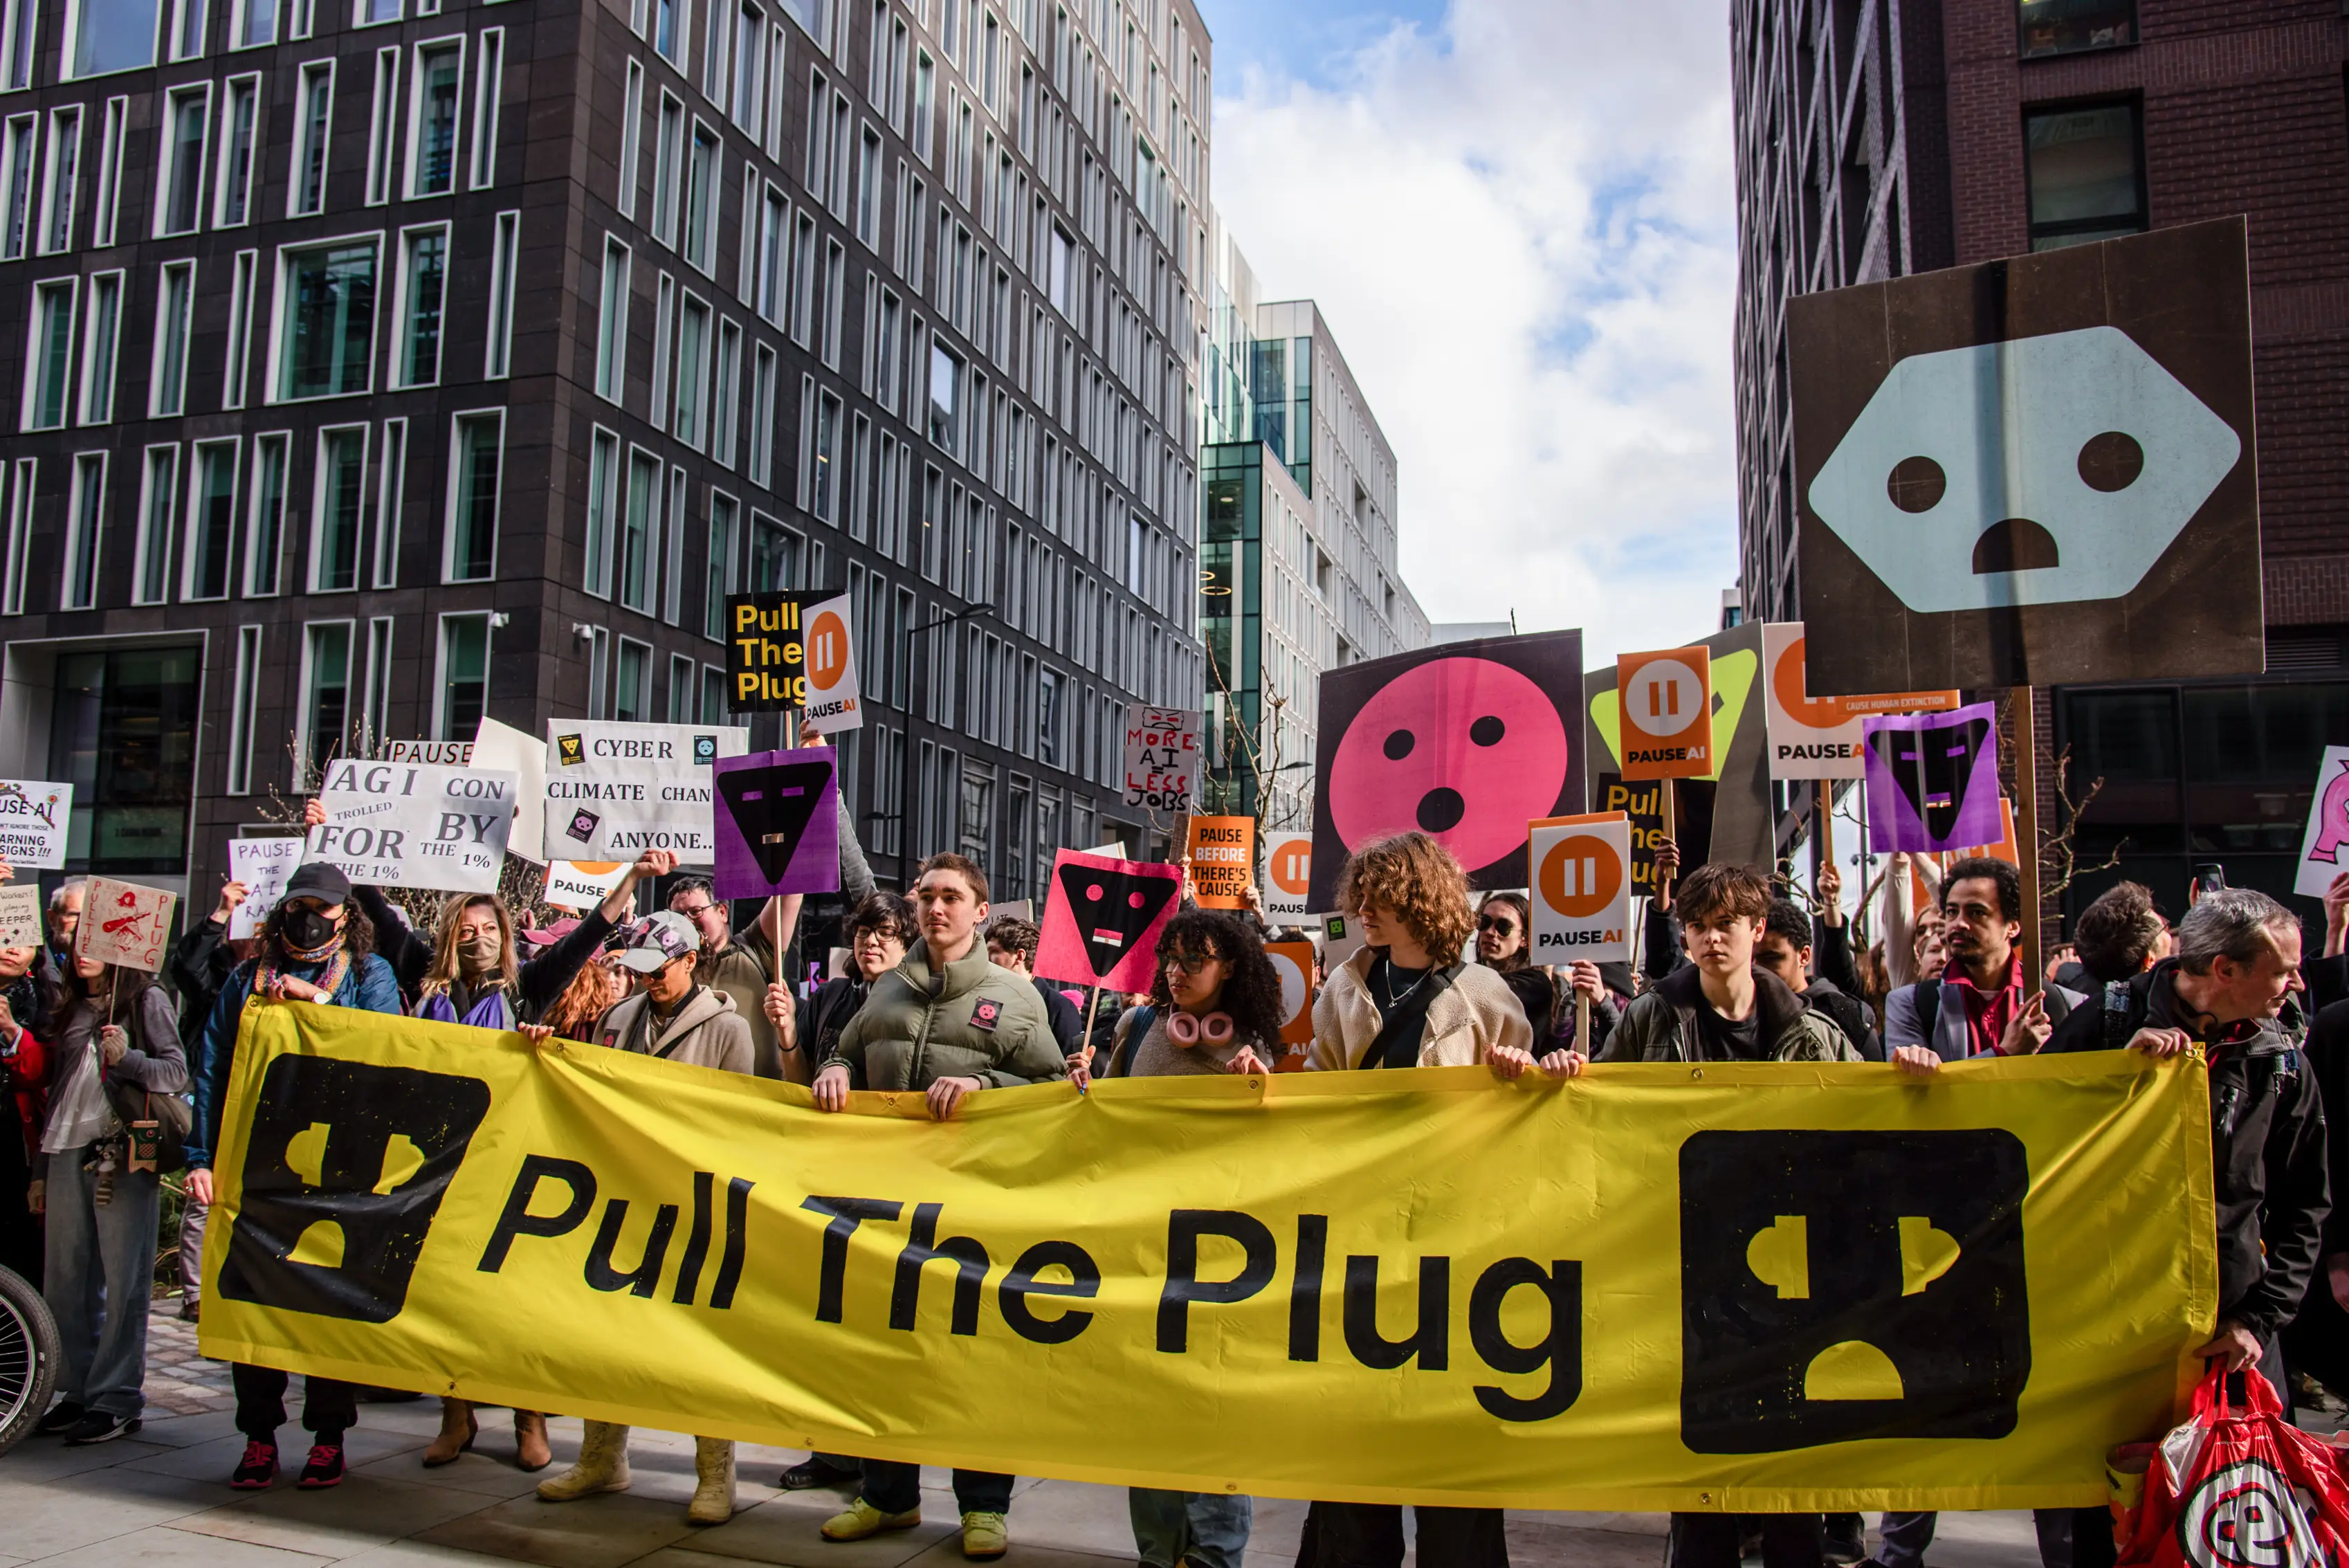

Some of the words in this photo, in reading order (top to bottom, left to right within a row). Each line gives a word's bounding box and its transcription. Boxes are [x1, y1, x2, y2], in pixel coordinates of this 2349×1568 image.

[736, 603, 799, 632] Pull
[736, 638, 803, 666] The
[738, 672, 806, 705] Plug
[807, 698, 856, 720] PAUSEAI
[1871, 699, 1899, 709] HUMAN
[1901, 695, 1946, 706] EXTINCTION
[594, 738, 674, 759] CYBER
[1128, 728, 1195, 751] MORE
[393, 742, 474, 764] PAUSE
[1627, 746, 1706, 763] PAUSEAI
[1777, 742, 1865, 760] PAUSEA
[446, 778, 506, 800] CON
[547, 781, 645, 801] CLIMATE
[661, 786, 711, 802] CHAN
[1127, 772, 1187, 794] LESS
[34, 802, 53, 817] AI
[1127, 789, 1190, 812] JOBS
[335, 801, 392, 821] TROLLED
[435, 812, 499, 844] BY
[1200, 828, 1243, 842] PAUSE
[1631, 821, 1665, 850] he
[0, 833, 46, 846] ARNING
[314, 825, 405, 859] FOR
[238, 842, 296, 859] PAUSE
[421, 842, 457, 857] THE
[462, 853, 491, 869] 1%
[1196, 846, 1246, 863] BEFORE
[257, 866, 280, 875] THE
[371, 865, 399, 879] 1%
[1193, 866, 1247, 882] THERE'S
[554, 879, 613, 897] PAUSE
[1198, 882, 1241, 897] CAUSE
[1270, 904, 1306, 913] PAUS
[1539, 929, 1623, 947] PAUSEAI
[476, 1154, 756, 1310] Pull
[800, 1194, 1102, 1344] The
[1156, 1209, 1582, 1423] Plug
